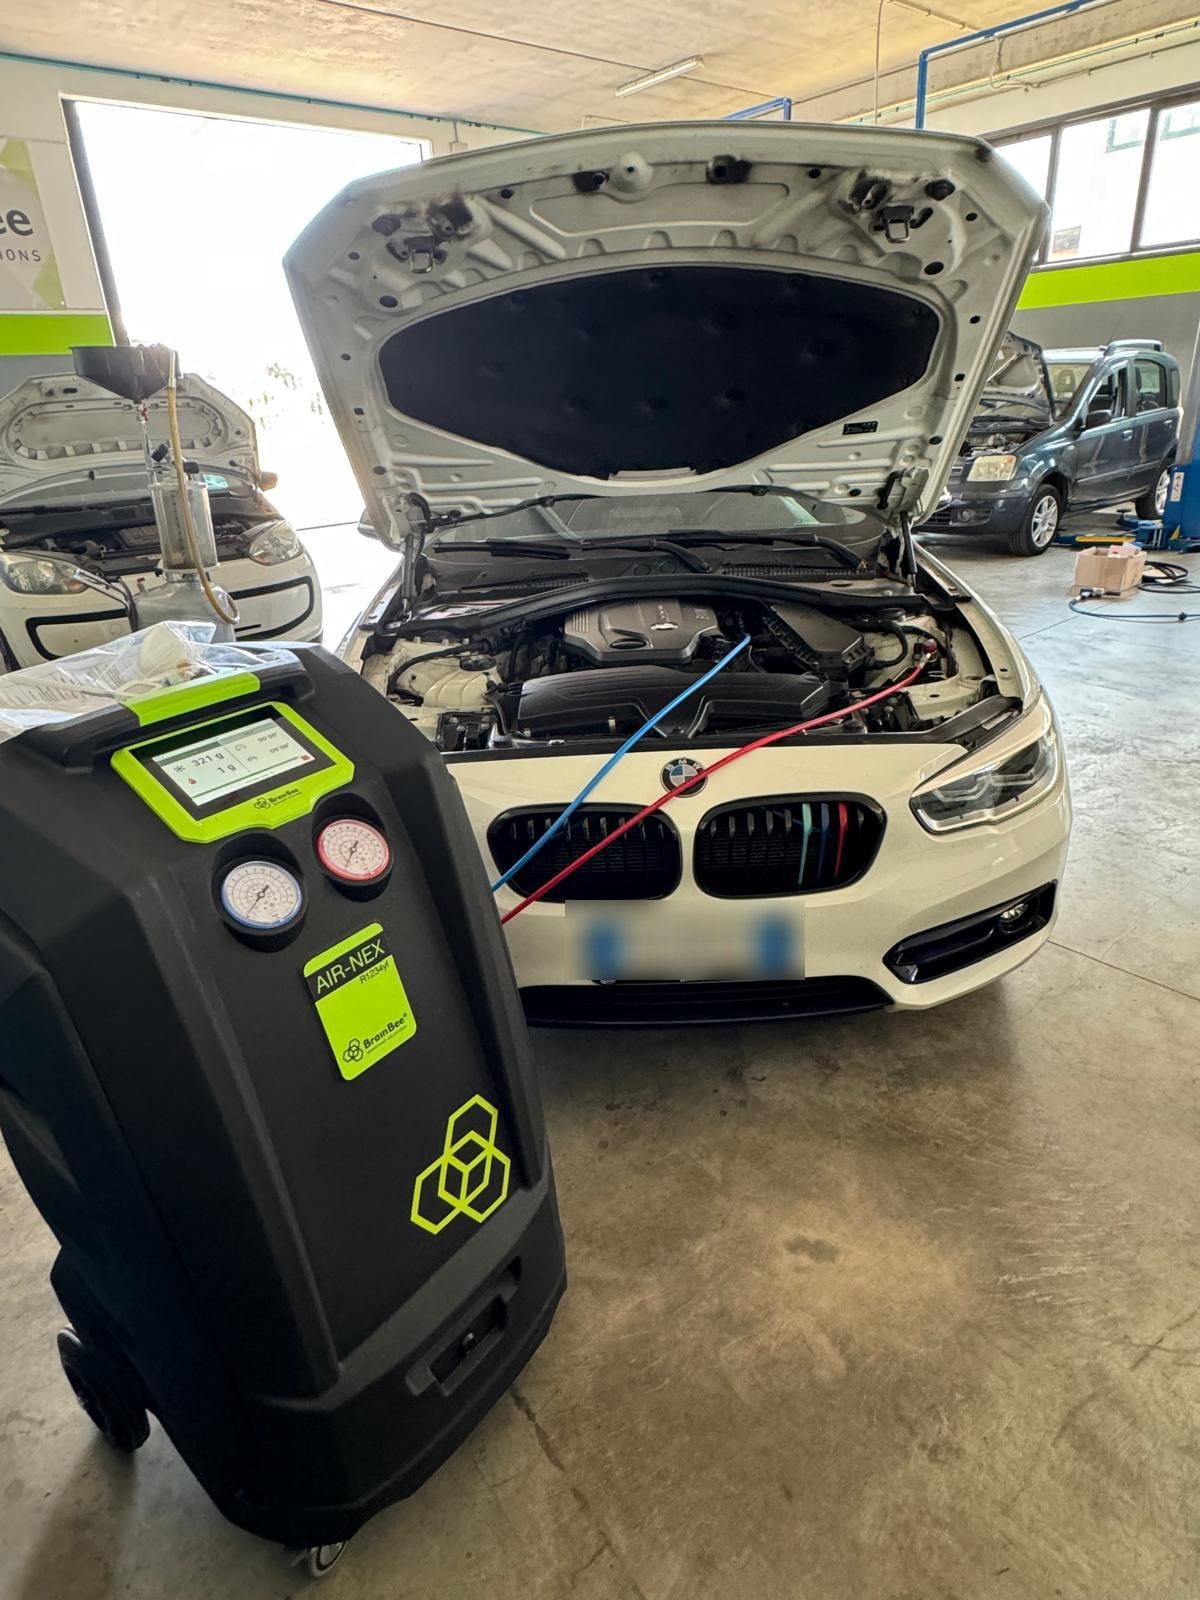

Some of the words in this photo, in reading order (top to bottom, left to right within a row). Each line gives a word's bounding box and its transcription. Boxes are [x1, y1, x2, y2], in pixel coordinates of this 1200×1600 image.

[191, 755, 213, 767] 321
[316, 939, 385, 994] AIR-NEX
[359, 960, 390, 985] R1234yf
